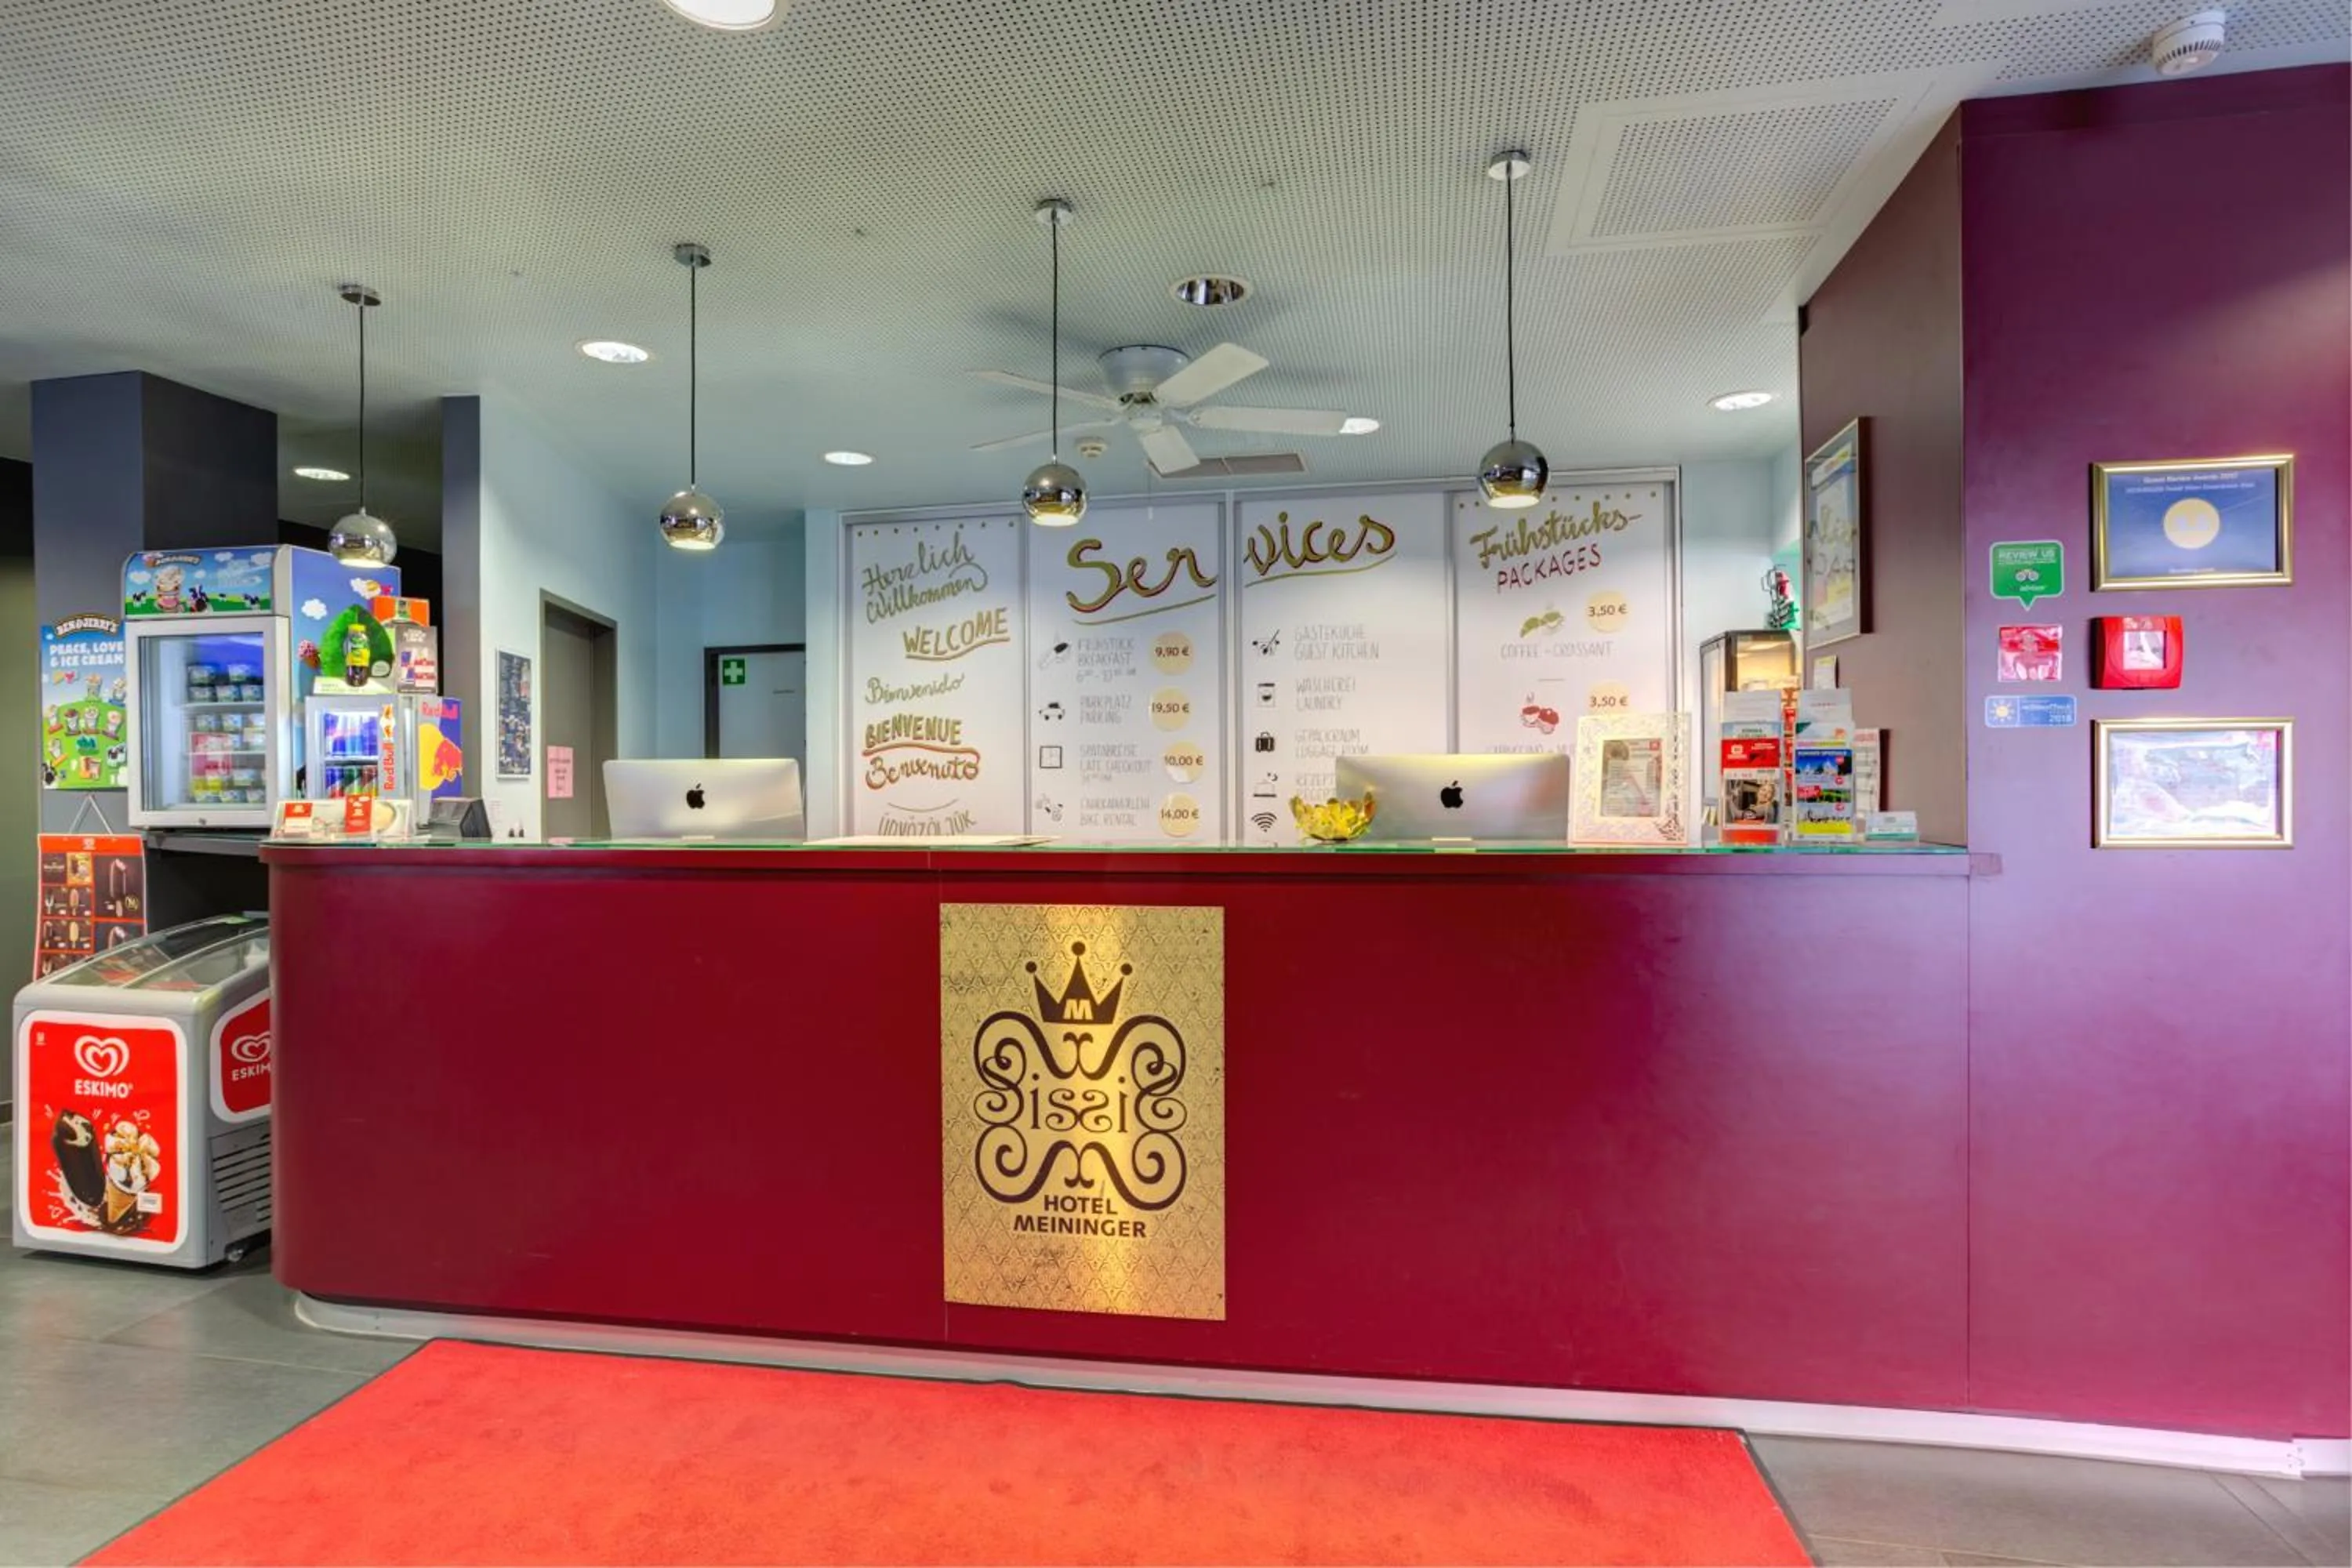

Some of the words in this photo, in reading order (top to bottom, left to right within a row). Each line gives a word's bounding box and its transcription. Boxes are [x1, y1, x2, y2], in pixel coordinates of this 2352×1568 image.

[1470, 501, 1642, 569] Frühstücks-
[862, 531, 975, 596] Herzlich
[1496, 543, 1601, 594] PACKAGES
[866, 562, 989, 624] Willkommen
[1588, 605, 1616, 616] 3,50
[1617, 603, 1628, 614] €
[902, 607, 1008, 656] WELCOME
[93, 641, 124, 654] LOVE
[1294, 642, 1328, 660] GUEST
[1331, 641, 1380, 660] KITCHEN
[1501, 643, 1540, 659] COFFEE
[1590, 696, 1616, 707] 3,50
[1619, 696, 1628, 706] €
[865, 713, 962, 748] BIENVENUE
[1079, 814, 1102, 826] BIKE
[1062, 998, 1094, 1020] M
[231, 1062, 271, 1082] ESKIM
[74, 1079, 129, 1098] ESKIMO
[1044, 1194, 1118, 1216] HOTEL
[1013, 1214, 1146, 1239] MEININGER
